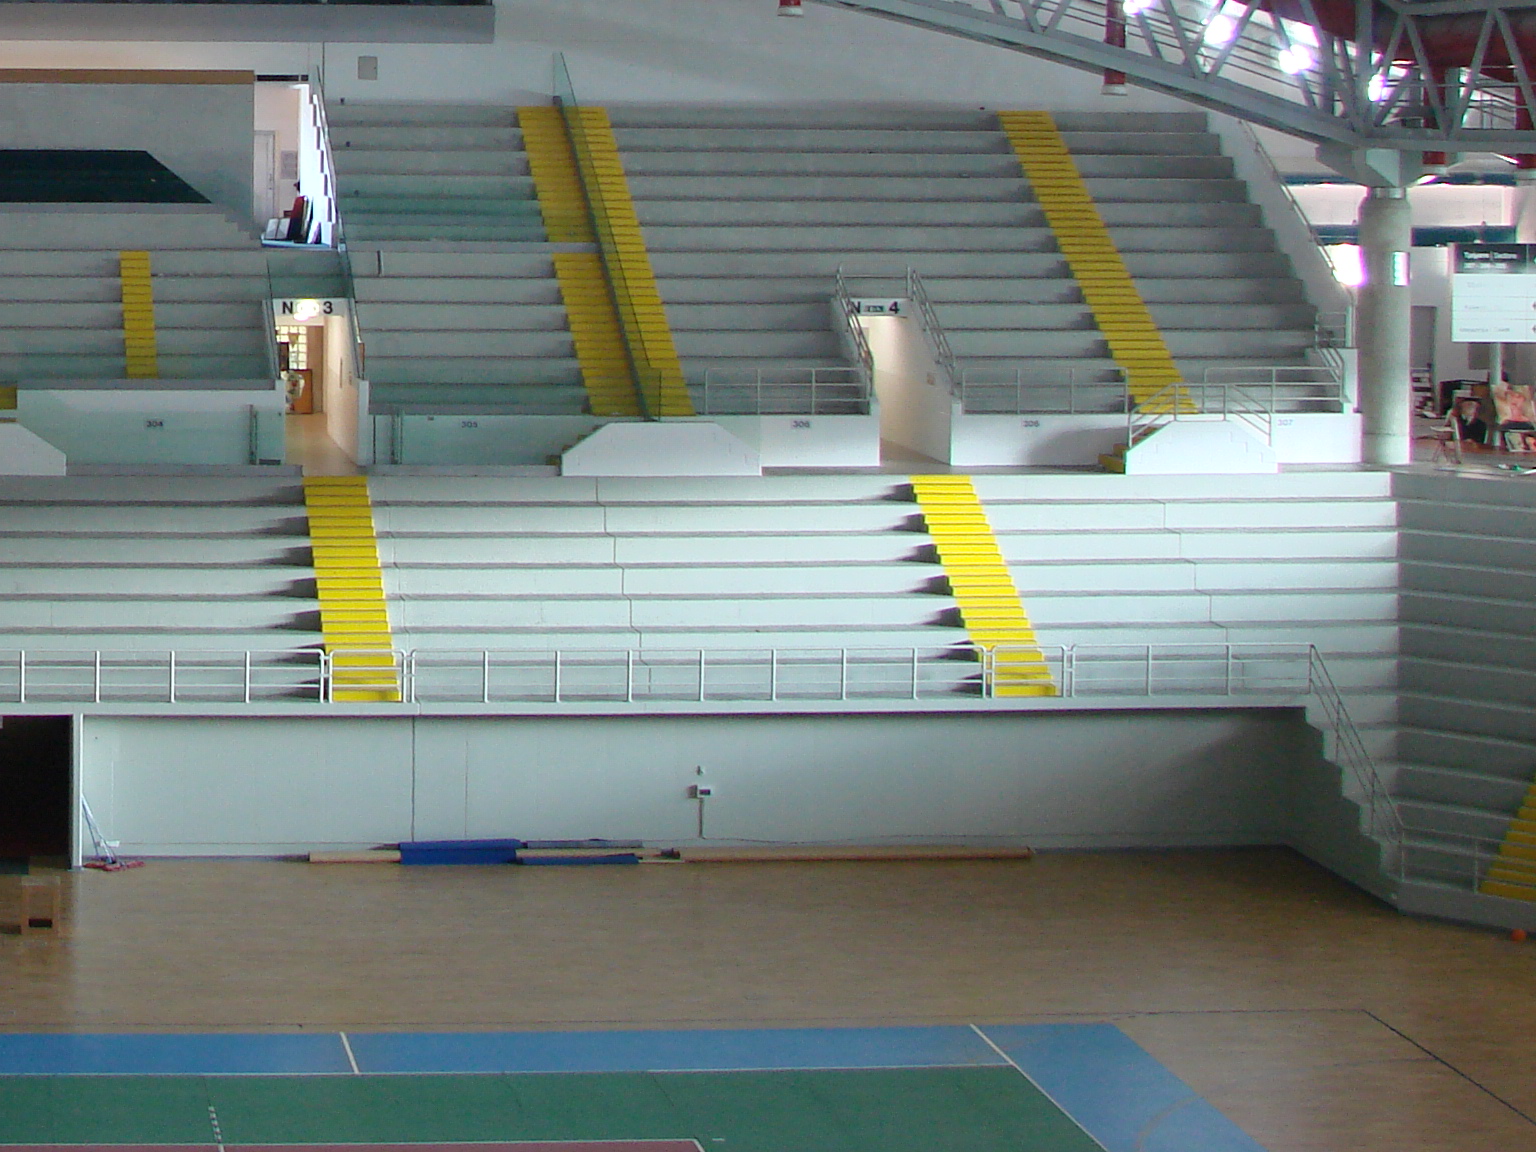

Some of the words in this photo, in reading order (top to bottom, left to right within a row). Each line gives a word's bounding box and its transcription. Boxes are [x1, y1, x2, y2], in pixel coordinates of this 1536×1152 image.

[282, 301, 293, 314] N
[323, 300, 333, 314] 3
[888, 301, 900, 315] 4
